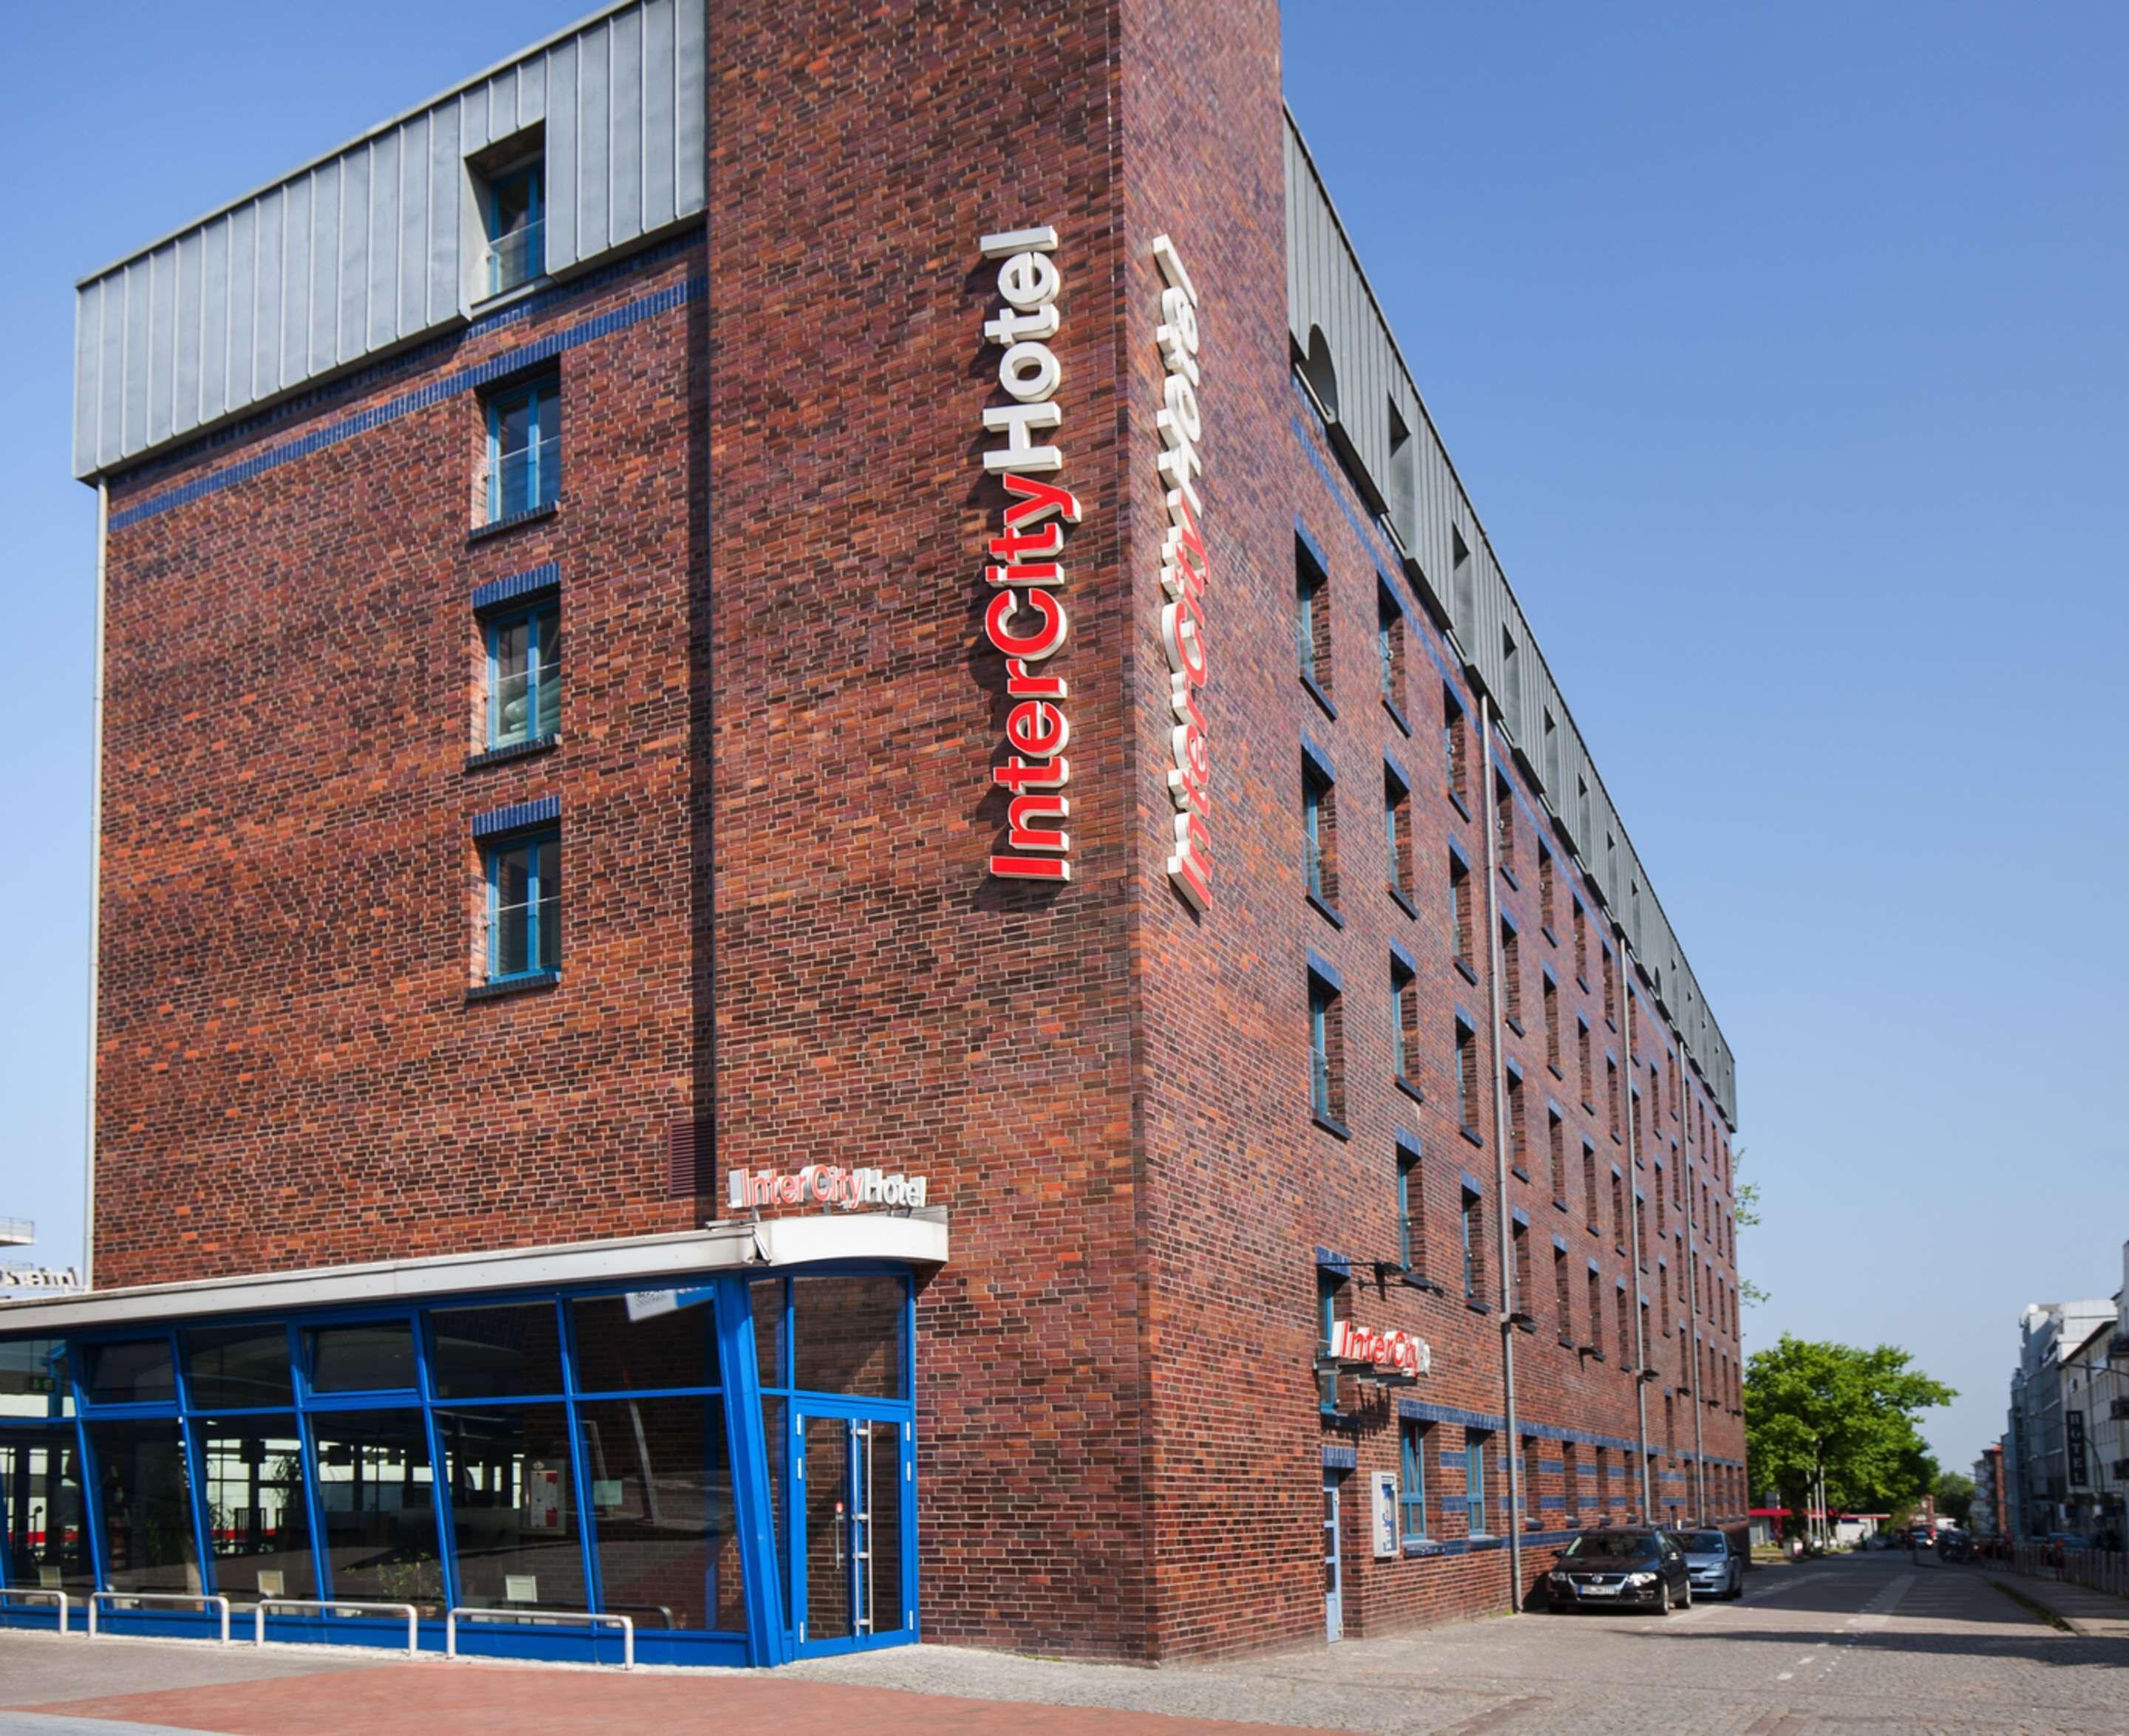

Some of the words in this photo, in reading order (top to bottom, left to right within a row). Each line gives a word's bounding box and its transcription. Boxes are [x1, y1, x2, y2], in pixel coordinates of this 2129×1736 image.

[980, 225, 1082, 881] InterCityHotel
[1153, 234, 1212, 911] InterCityHotel
[729, 1164, 927, 1210] InterCityHotel
